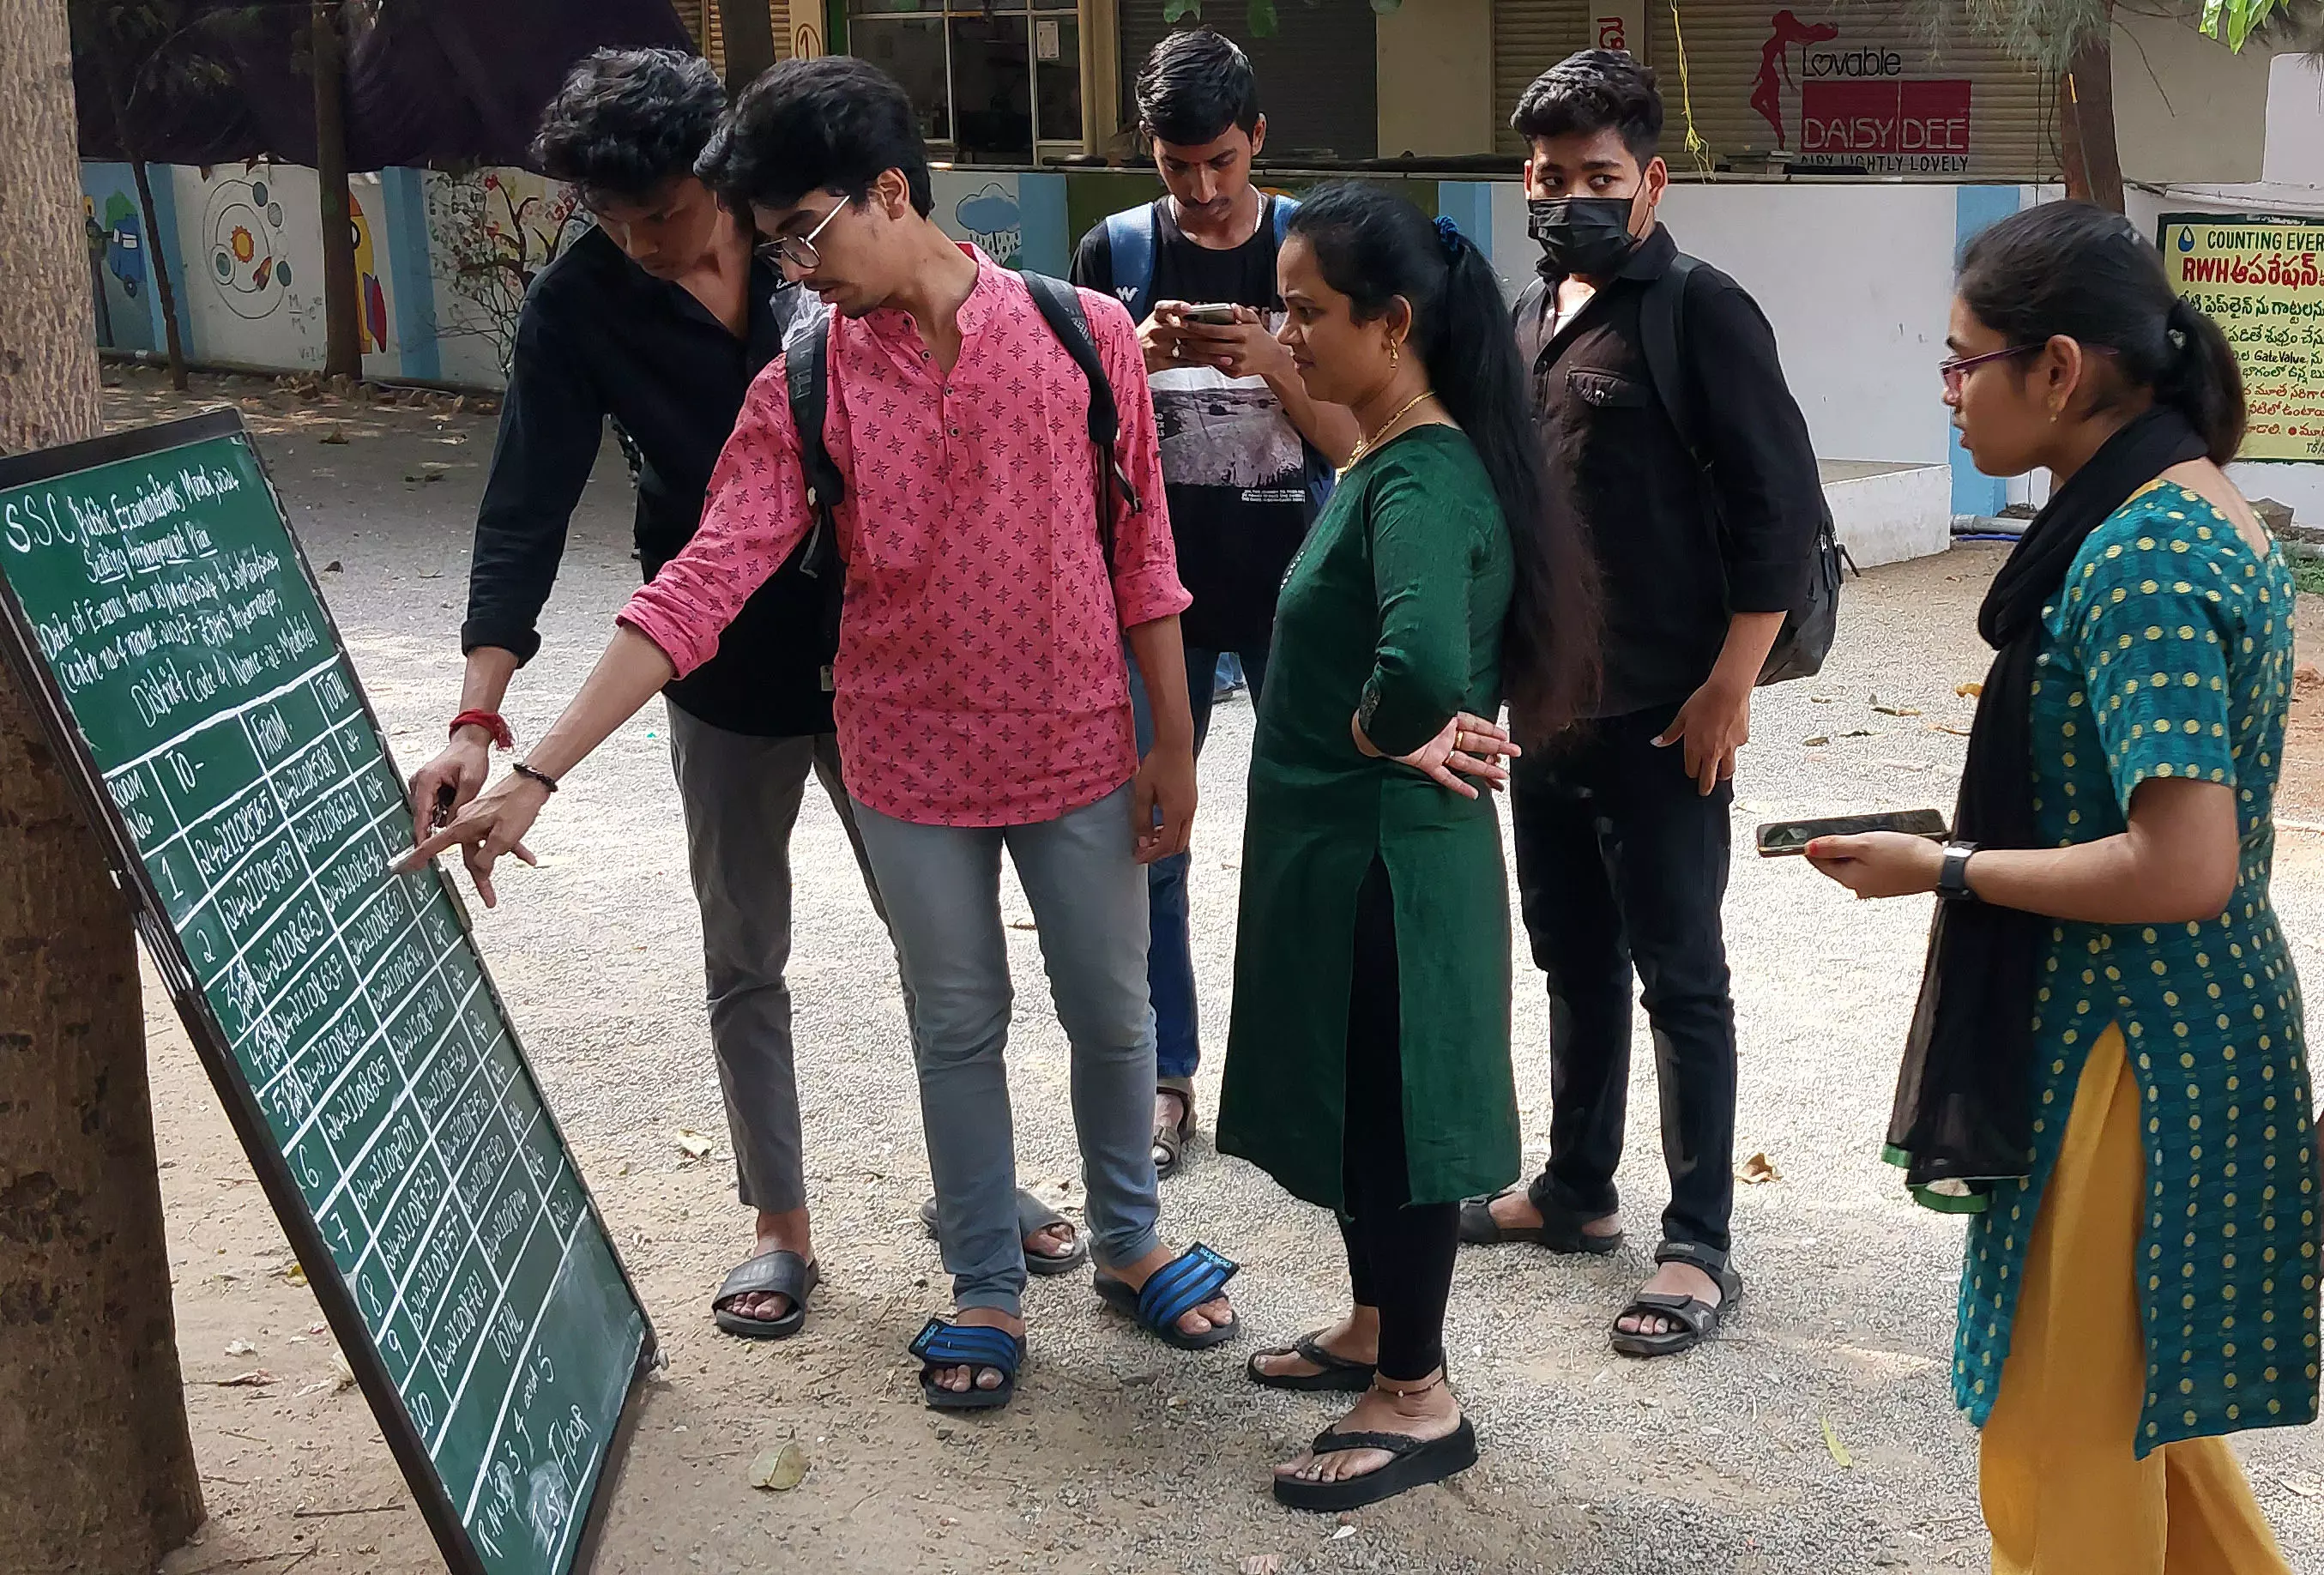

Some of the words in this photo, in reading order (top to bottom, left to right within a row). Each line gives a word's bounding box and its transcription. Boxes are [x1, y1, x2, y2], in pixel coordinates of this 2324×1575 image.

[1802, 45, 1902, 76] Lovable
[1803, 117, 1894, 148] DAISY
[1902, 118, 1965, 149] DEE
[1910, 155, 1969, 172] LOVELY
[2207, 231, 2282, 250] COUNTING
[66, 495, 118, 548] Public
[83, 541, 135, 582] Seating
[184, 520, 213, 555] Plan
[39, 612, 74, 661] Date
[71, 600, 87, 635] of
[213, 560, 231, 594] to
[59, 647, 104, 694] Centre
[130, 657, 189, 728] District
[186, 661, 219, 703] Code
[106, 769, 149, 809] ROOM
[161, 854, 184, 902] 1
[195, 788, 274, 875] 2421108565
[343, 727, 361, 753] 24
[196, 928, 217, 963] 2
[222, 840, 299, 930] 2421108589
[365, 771, 387, 804] 24
[220, 981, 246, 1034] 3
[252, 901, 324, 993] 2421108613
[245, 1040, 266, 1078] 4
[275, 953, 344, 1045] 2421108637
[271, 1085, 290, 1128] 5
[299, 1005, 366, 1096] 2421108661
[299, 1144, 320, 1188] 6
[325, 1054, 391, 1142] 2421108685
[329, 1210, 353, 1254] 7
[356, 1113, 420, 1211] 2421108709
[361, 1273, 383, 1318] 8
[383, 1160, 441, 1271] 2421108733
[387, 1329, 409, 1367] 9
[411, 1204, 462, 1331] 2421108757
[410, 1391, 434, 1439] 10
[432, 1268, 487, 1379] 2421108781
[487, 1301, 524, 1365] TOTAL
[537, 1343, 554, 1384] 5
